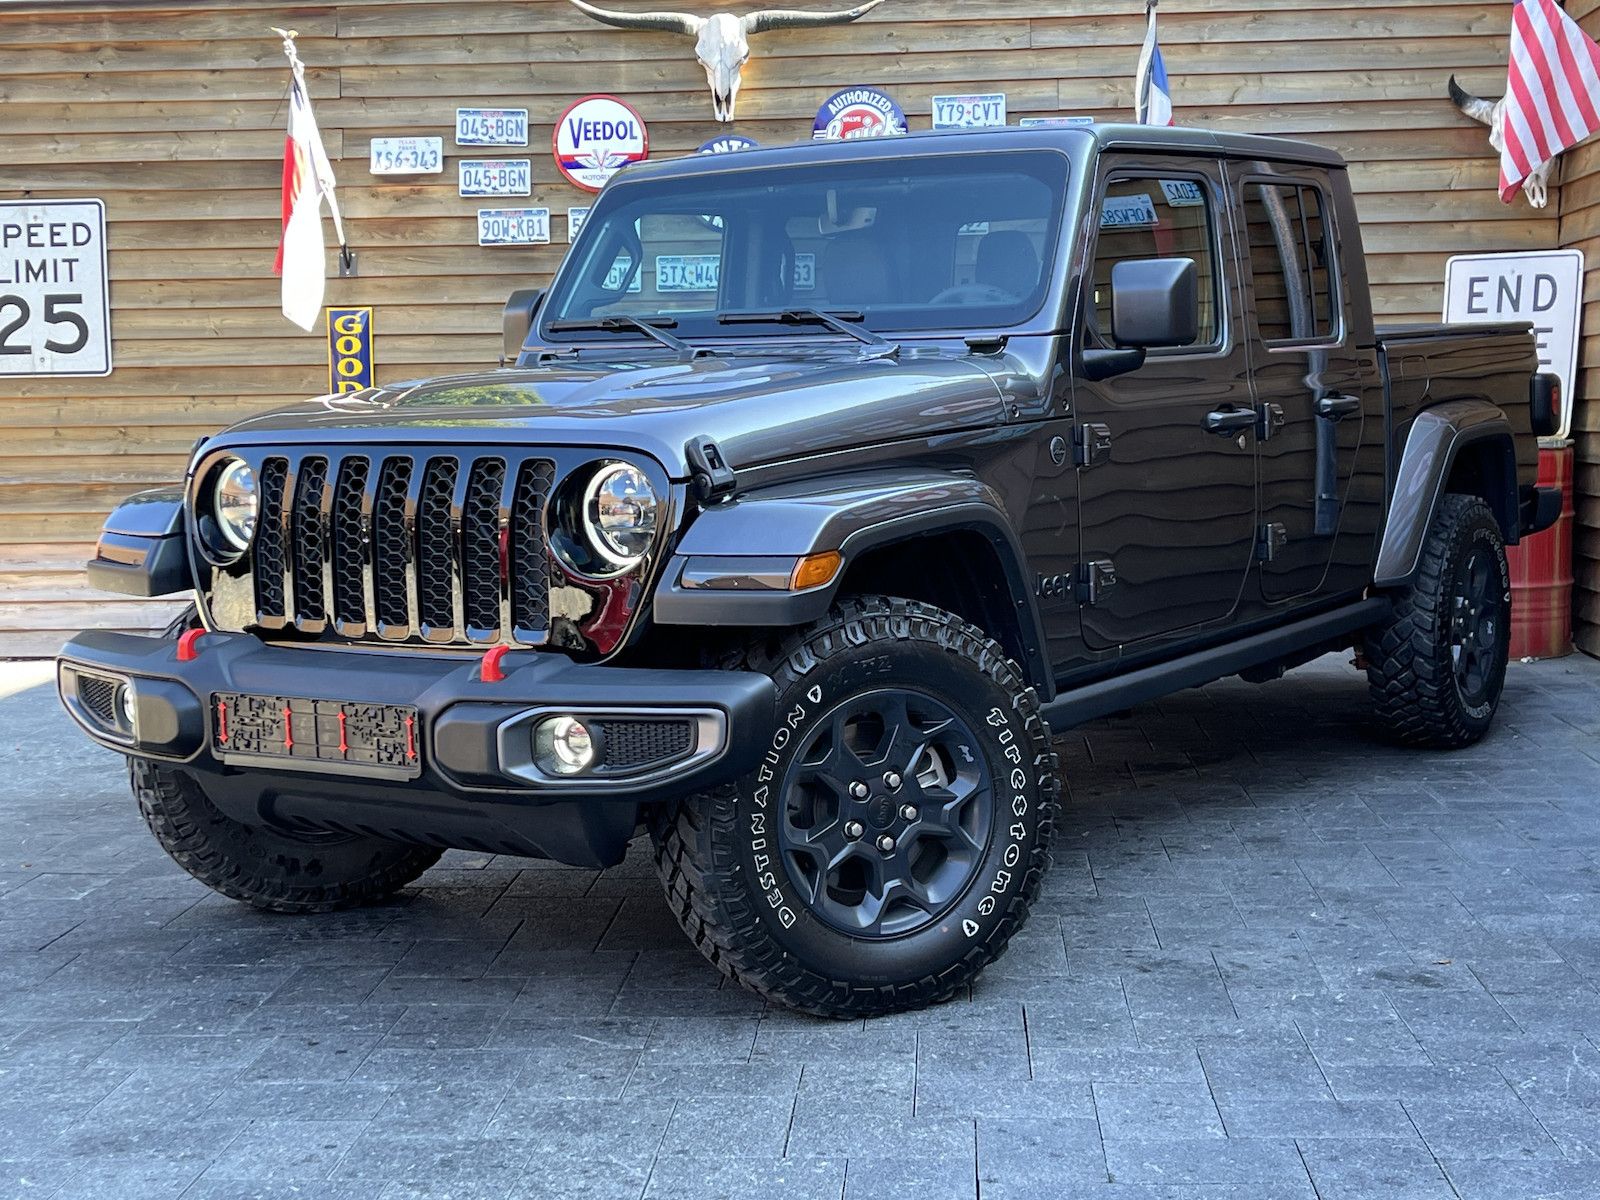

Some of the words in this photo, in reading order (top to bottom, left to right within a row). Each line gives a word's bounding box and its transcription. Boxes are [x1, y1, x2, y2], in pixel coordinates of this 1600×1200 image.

[828, 90, 892, 115] AUTHORIZED
[936, 104, 964, 122] Y79
[972, 102, 1000, 121] CVT
[495, 118, 524, 138] BGN
[569, 117, 638, 149] VEEDOL
[410, 150, 438, 168] 343
[499, 169, 527, 187] BGN
[2, 222, 92, 248] PEED
[516, 219, 545, 237] KB1
[1467, 273, 1558, 314] END
[0, 294, 89, 354] 25
[334, 314, 364, 394] GOOD
[1036, 571, 1071, 600] Jeep
[752, 705, 805, 930] DESTINATION
[978, 706, 1028, 918] Firestone
